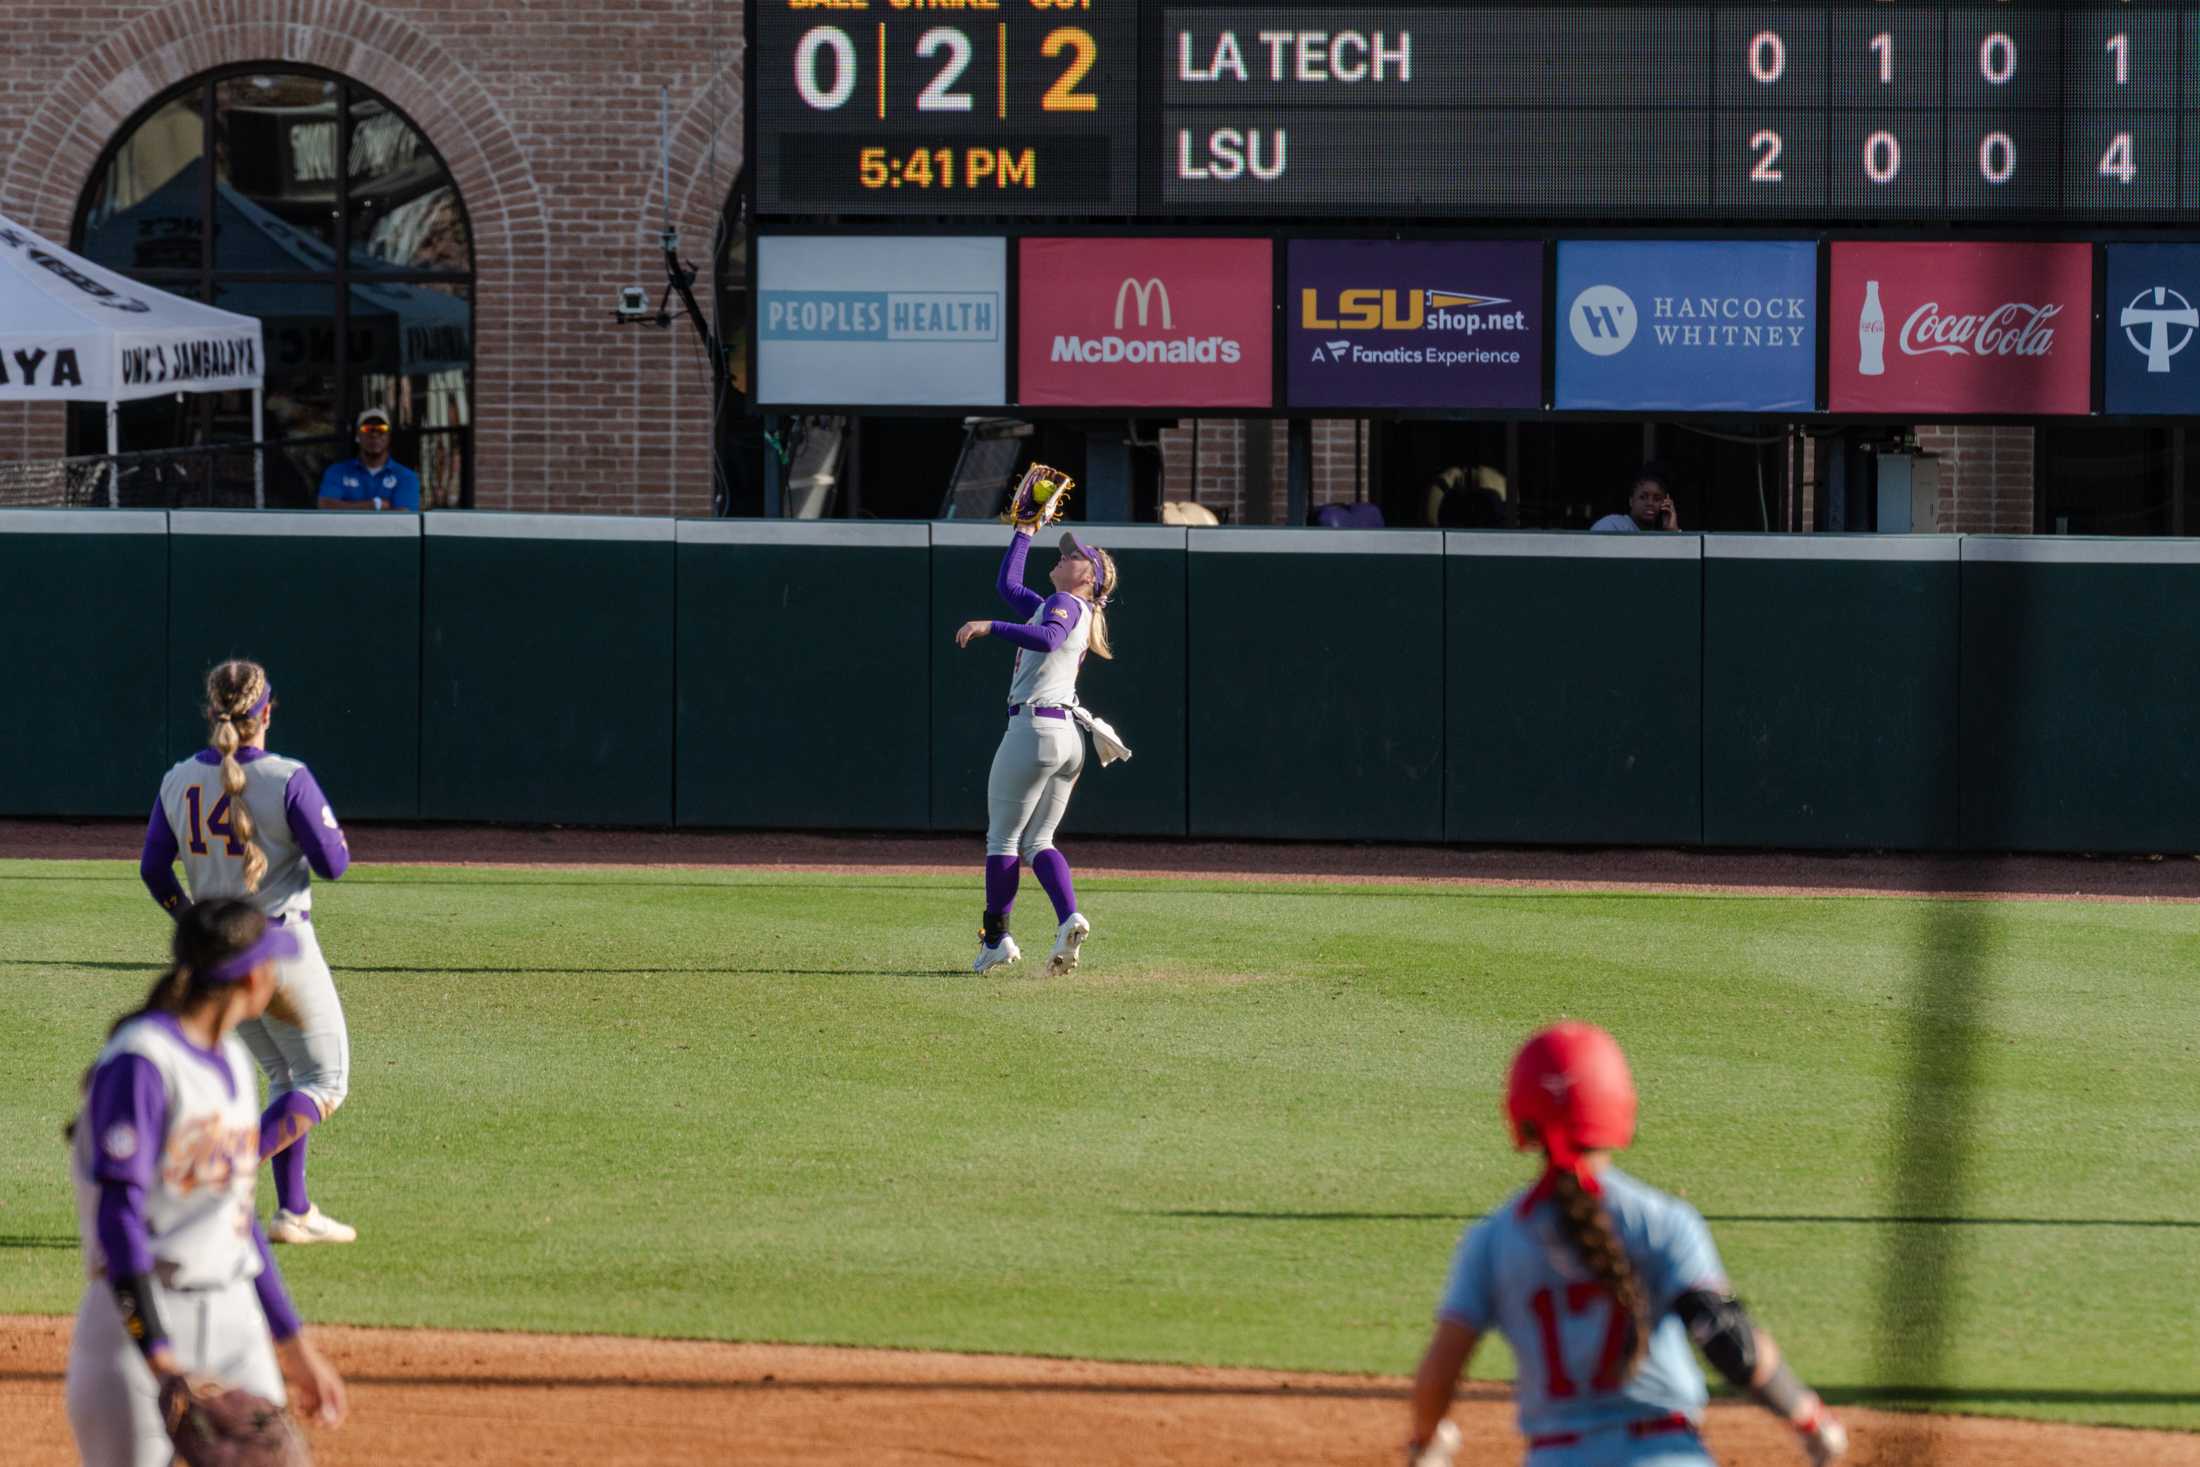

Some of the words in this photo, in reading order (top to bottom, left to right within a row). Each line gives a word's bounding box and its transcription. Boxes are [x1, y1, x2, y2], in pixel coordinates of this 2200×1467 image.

[795, 26, 857, 110] 0
[915, 28, 974, 111] 2
[1041, 28, 1097, 111] 2
[1178, 32, 1248, 81] LA
[1259, 32, 1411, 82] TECH
[1749, 31, 1786, 83] 0
[1871, 34, 1894, 84] 1
[1980, 32, 2016, 84] 0
[2106, 34, 2130, 84] 1
[859, 149, 954, 189] 5:41
[966, 149, 1036, 189] PM
[1178, 129, 1287, 180] LSU
[1751, 130, 1783, 182] 2
[1864, 131, 1901, 183] 0
[1980, 132, 2016, 184] 0
[2100, 132, 2137, 184] 4
[767, 302, 881, 332] PEOPLES
[893, 302, 992, 332] HEALTH
[1302, 288, 1424, 331] LSU
[1426, 308, 1525, 336] shop.net
[1653, 297, 1805, 320] HANCOCK
[1899, 302, 2064, 357] Coca-Cola
[1051, 335, 1241, 364] McDonald's
[1311, 347, 1326, 363] A
[1353, 345, 1424, 364] Fanatics
[1426, 347, 1521, 368] Experience
[1654, 325, 1804, 347] WHITNEY
[173, 338, 257, 382] JAMBALAYA
[186, 784, 249, 857] 14
[1529, 1280, 1631, 1398] 17
